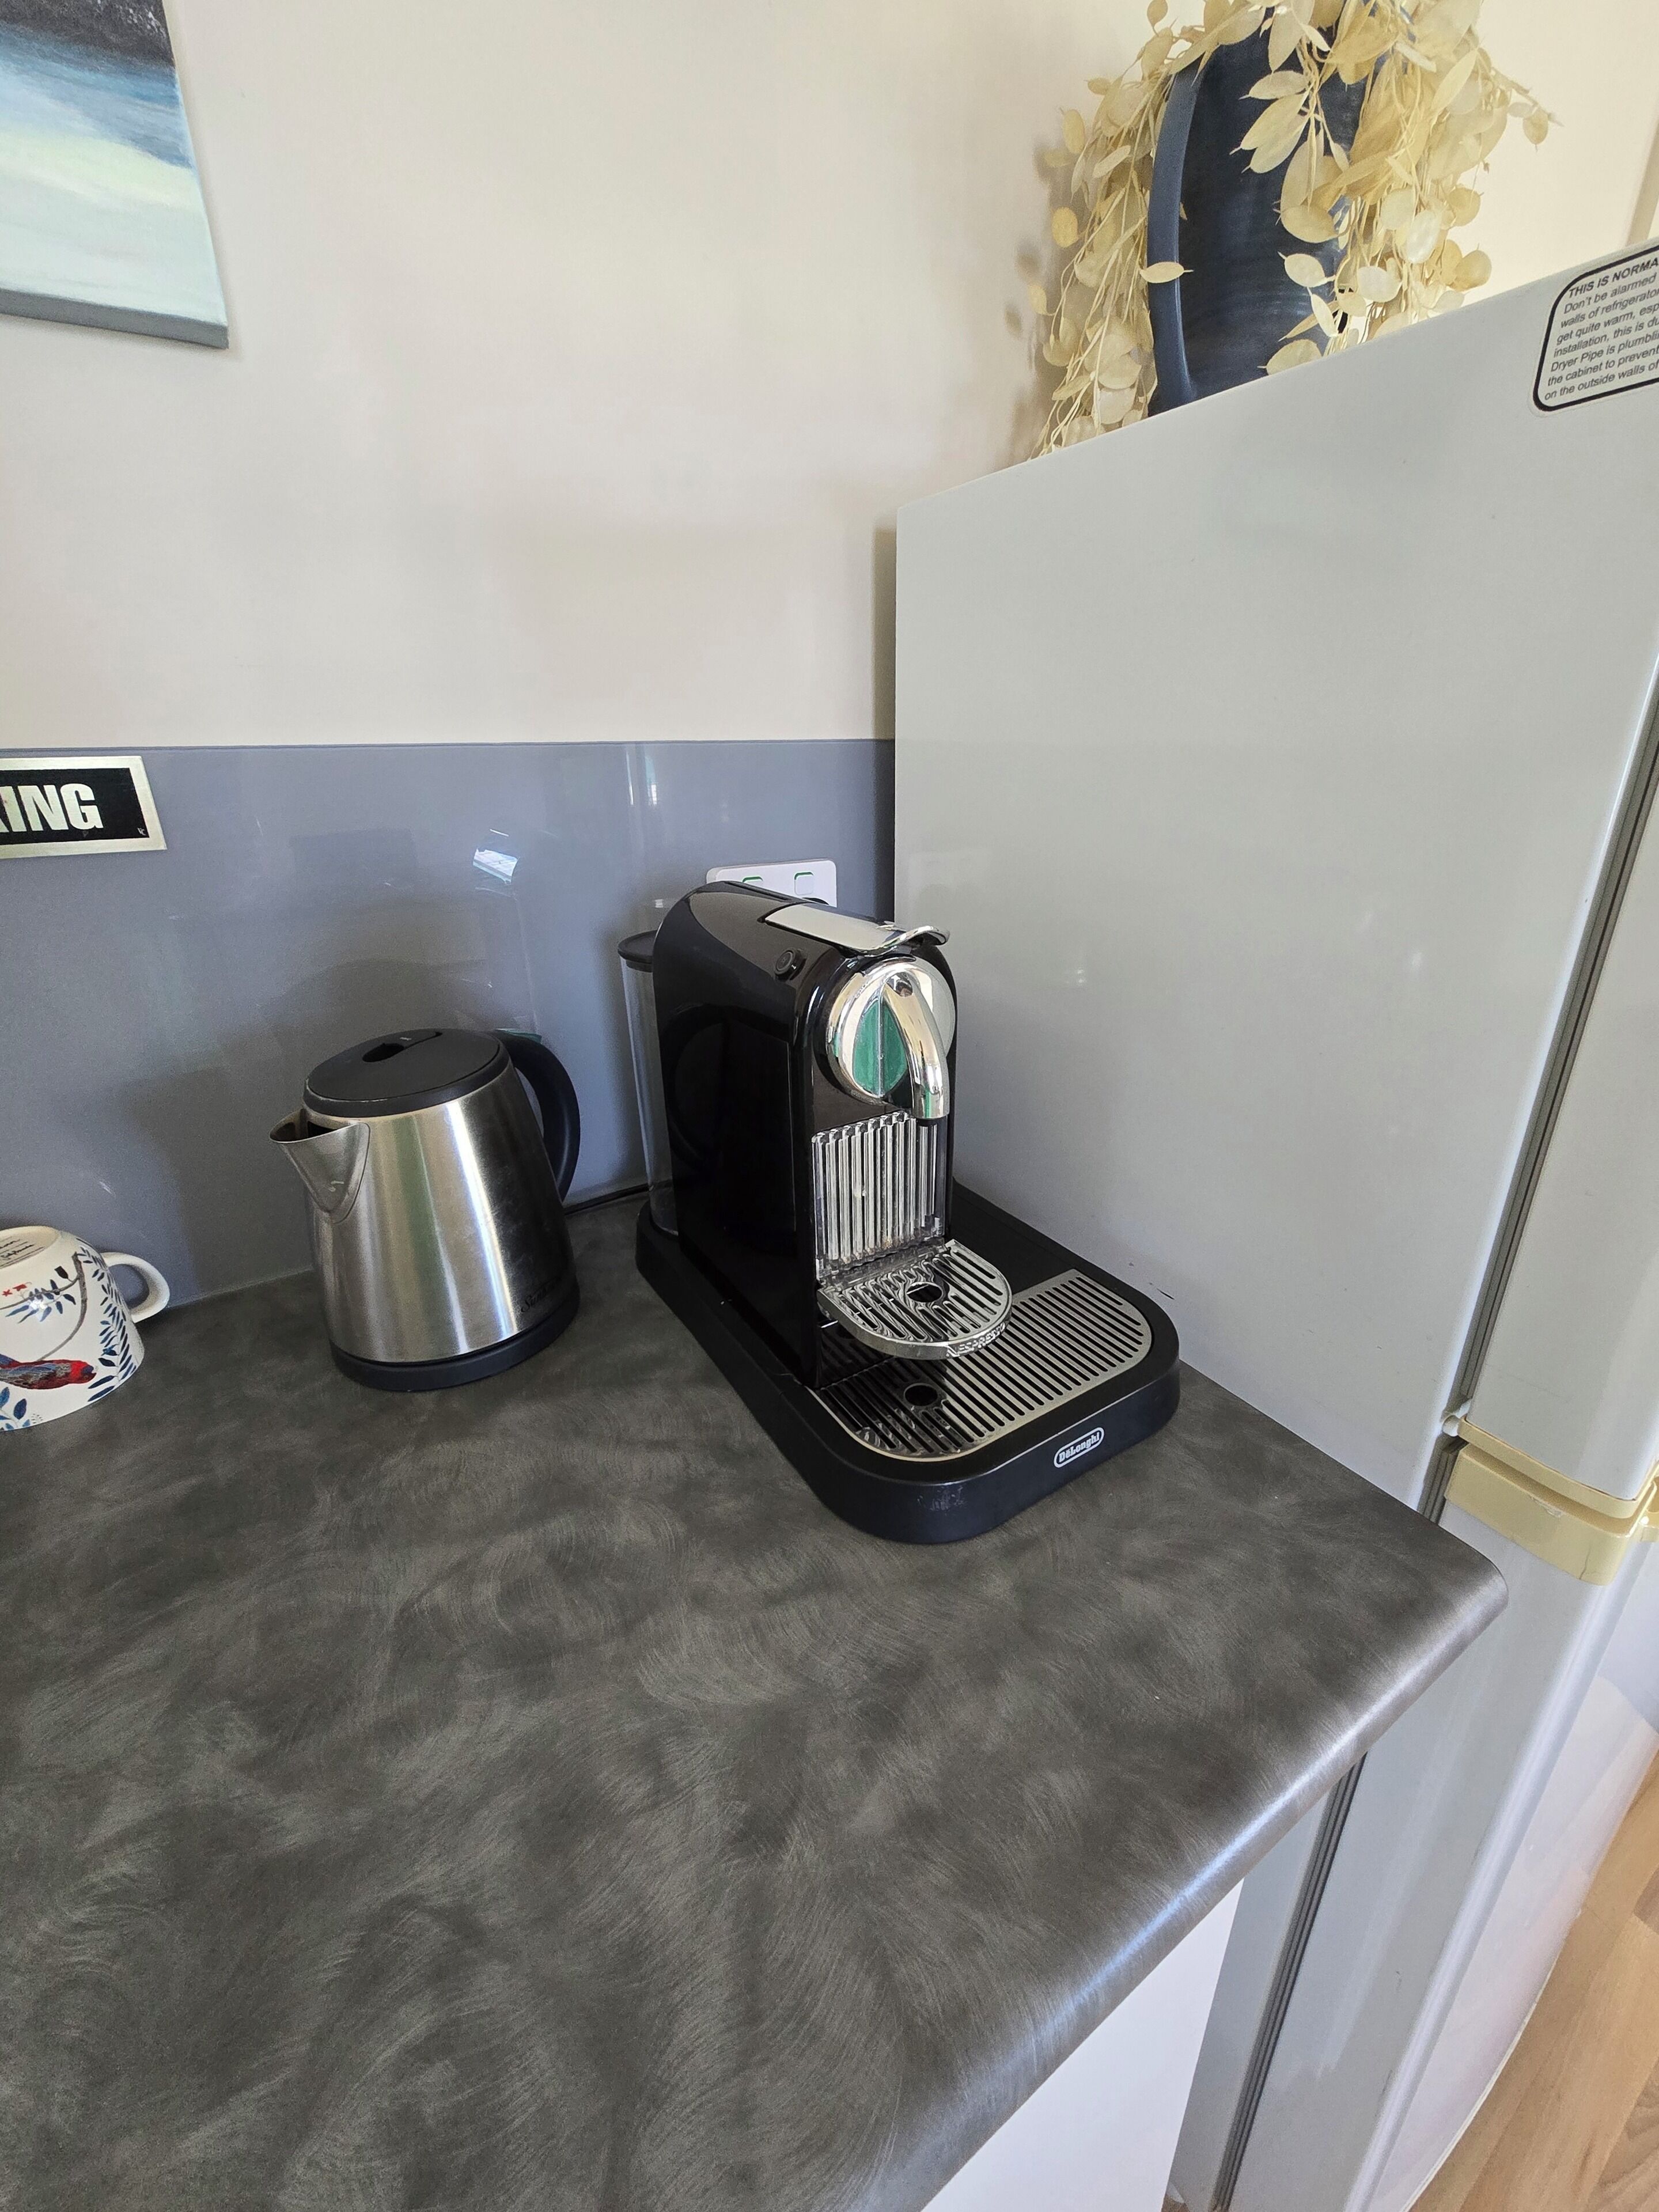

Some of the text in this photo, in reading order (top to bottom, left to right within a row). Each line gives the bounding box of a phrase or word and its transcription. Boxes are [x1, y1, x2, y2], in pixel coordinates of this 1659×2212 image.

[1563, 272, 1657, 315] Don't be alarmed
[1569, 281, 1594, 298] THIS
[1597, 275, 1609, 288] IS
[1556, 330, 1574, 346] get
[1575, 321, 1601, 338] quite
[1603, 312, 1635, 328] warm,
[1560, 313, 1586, 329] walls
[1588, 306, 1600, 320] of
[1553, 334, 1610, 358] installation,
[1613, 325, 1633, 339] this
[1634, 321, 1645, 332] is
[1547, 376, 1563, 387] the
[1565, 362, 1603, 381] cabinet
[1605, 359, 1615, 370] to
[1550, 357, 1579, 373] Dryer
[1580, 349, 1604, 363] Pipe
[1606, 343, 1615, 356] is
[1544, 390, 1557, 401] on
[1559, 385, 1575, 396] the
[1577, 373, 1616, 392] outside
[1618, 364, 1646, 380] walls
[0, 783, 104, 833] ING
